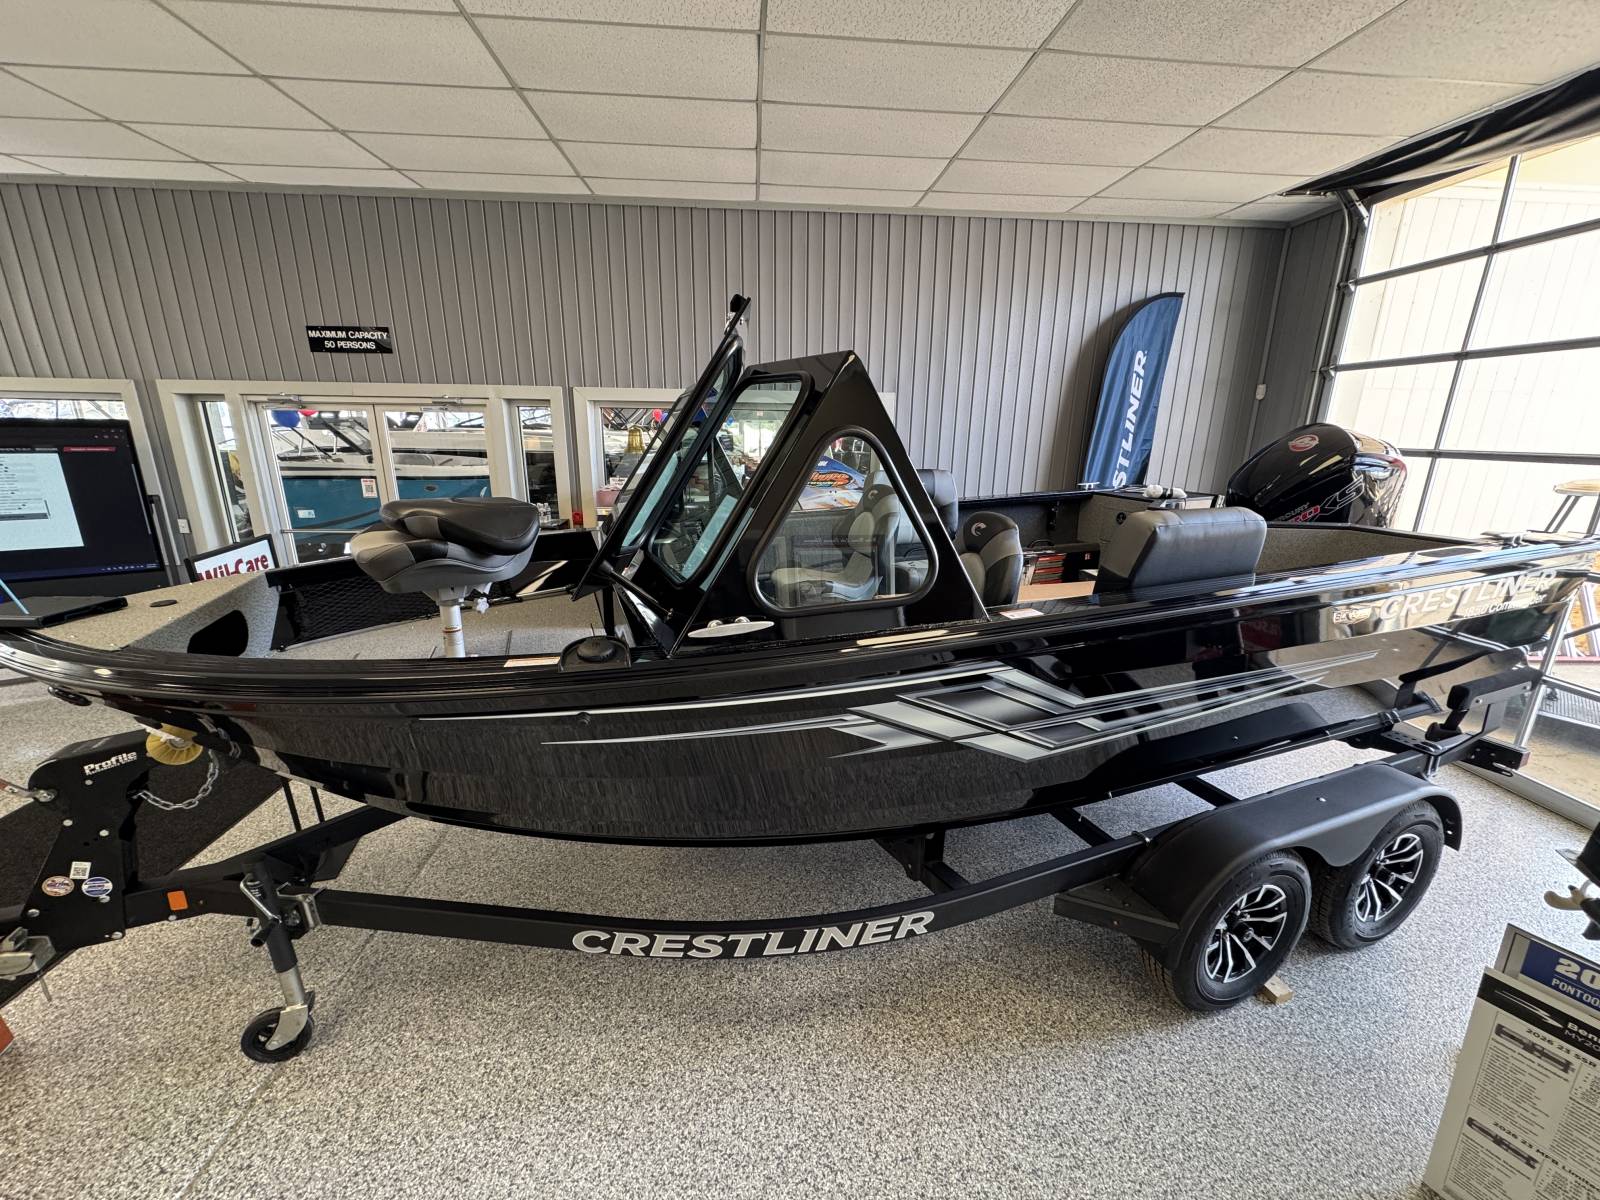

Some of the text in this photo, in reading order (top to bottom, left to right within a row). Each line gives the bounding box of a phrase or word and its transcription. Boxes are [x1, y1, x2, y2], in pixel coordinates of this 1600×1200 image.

[308, 330, 388, 339] MAXIMUM CAPACITY
[337, 341, 376, 349] PERSONS
[1380, 569, 1557, 620] CRESTLINER
[84, 752, 137, 774] Profile
[572, 911, 935, 958] CRESTLINER
[1551, 978, 1600, 1008] PONTOO
